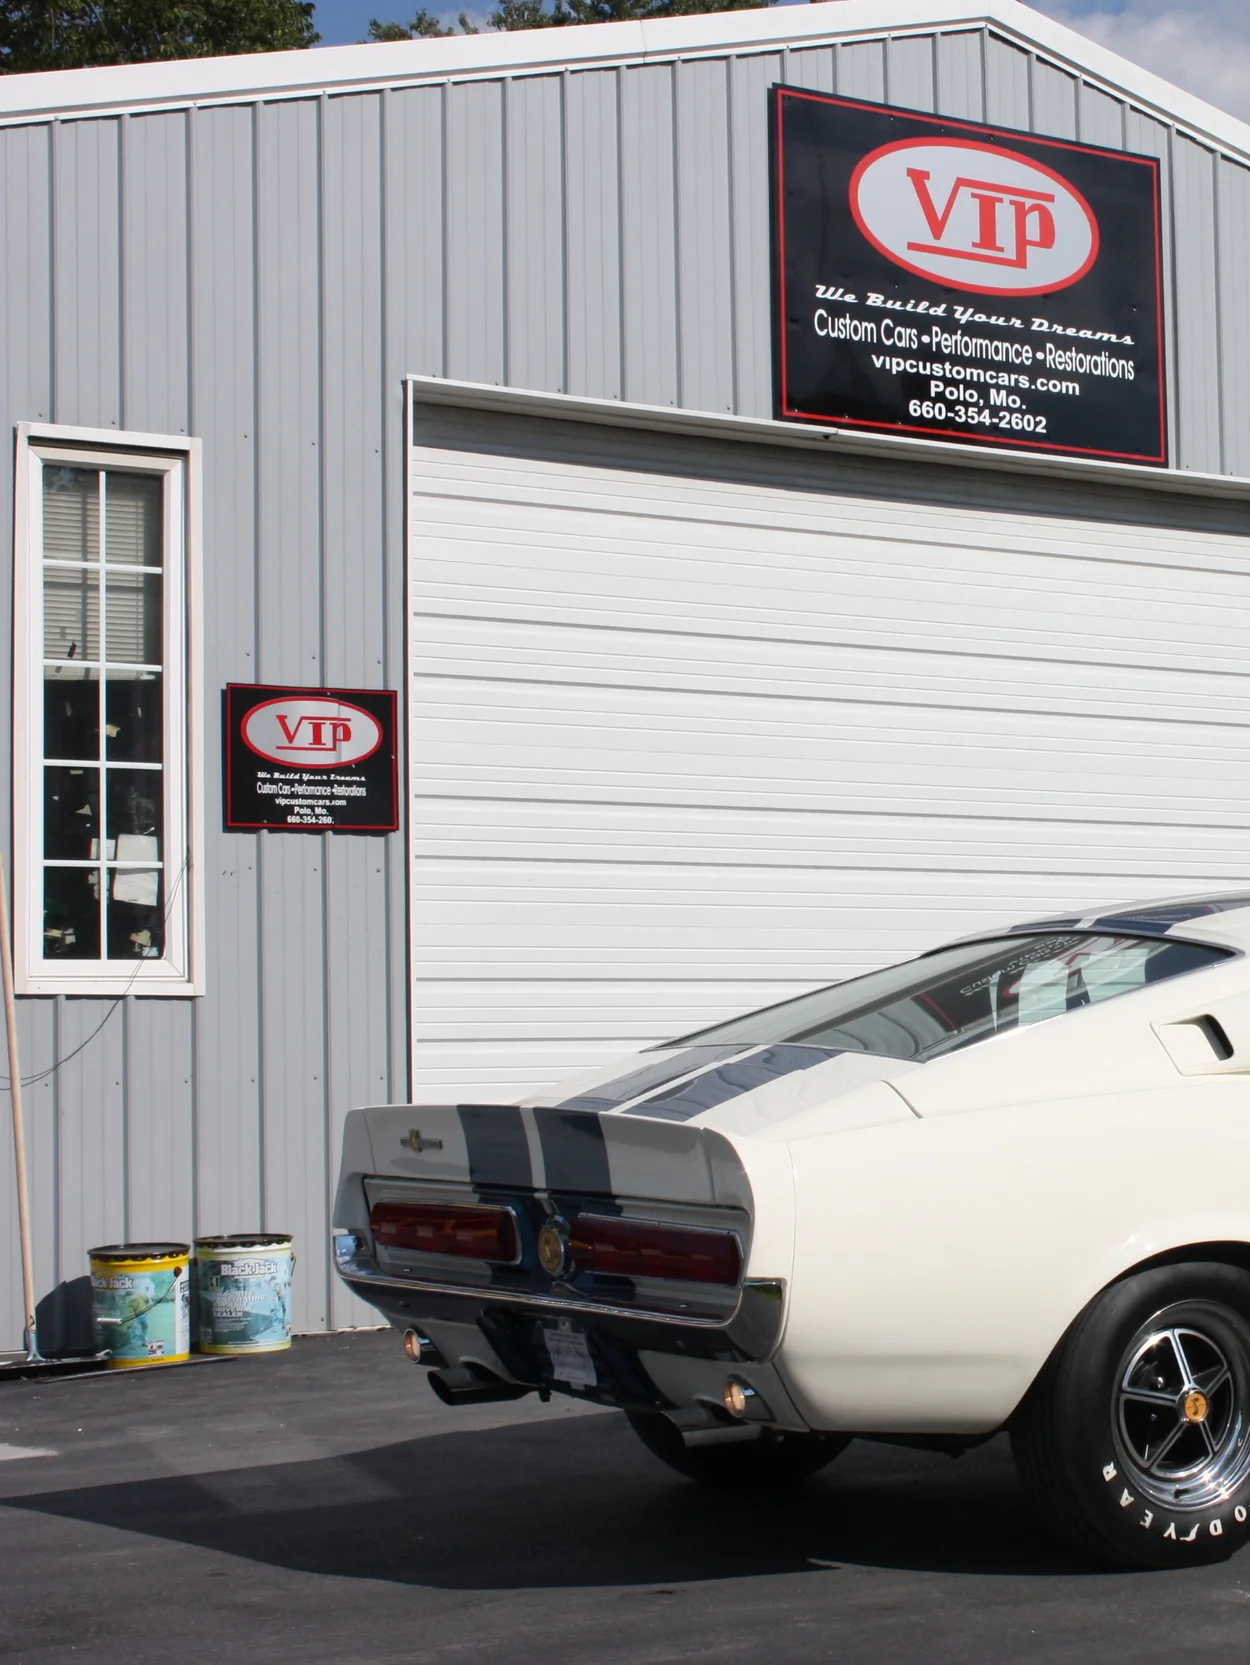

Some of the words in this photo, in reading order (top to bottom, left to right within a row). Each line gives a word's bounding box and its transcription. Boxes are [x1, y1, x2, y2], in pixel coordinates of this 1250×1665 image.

[815, 284, 859, 303] We
[866, 292, 948, 317] Build
[953, 305, 1025, 329] Your
[1031, 318, 1135, 346] Dreams
[813, 309, 877, 344] Custom
[880, 318, 919, 350] Cars
[931, 325, 1033, 366] Performance
[1045, 342, 1135, 381] Restorations
[871, 354, 1080, 396] vipcustomcars.com
[930, 379, 985, 407] Polo,
[989, 387, 1027, 410] Mo.
[908, 399, 1047, 434] 660-354-2602
[273, 772, 300, 780] Build
[302, 773, 328, 781] Your
[257, 782, 277, 794] Custom
[294, 806, 314, 816] Polo,
[314, 807, 329, 815] Mo.
[287, 815, 335, 825] 660-354-260
[221, 1263, 252, 1276] Black
[252, 1262, 277, 1274] Jack
[110, 1276, 133, 1289] Jack
